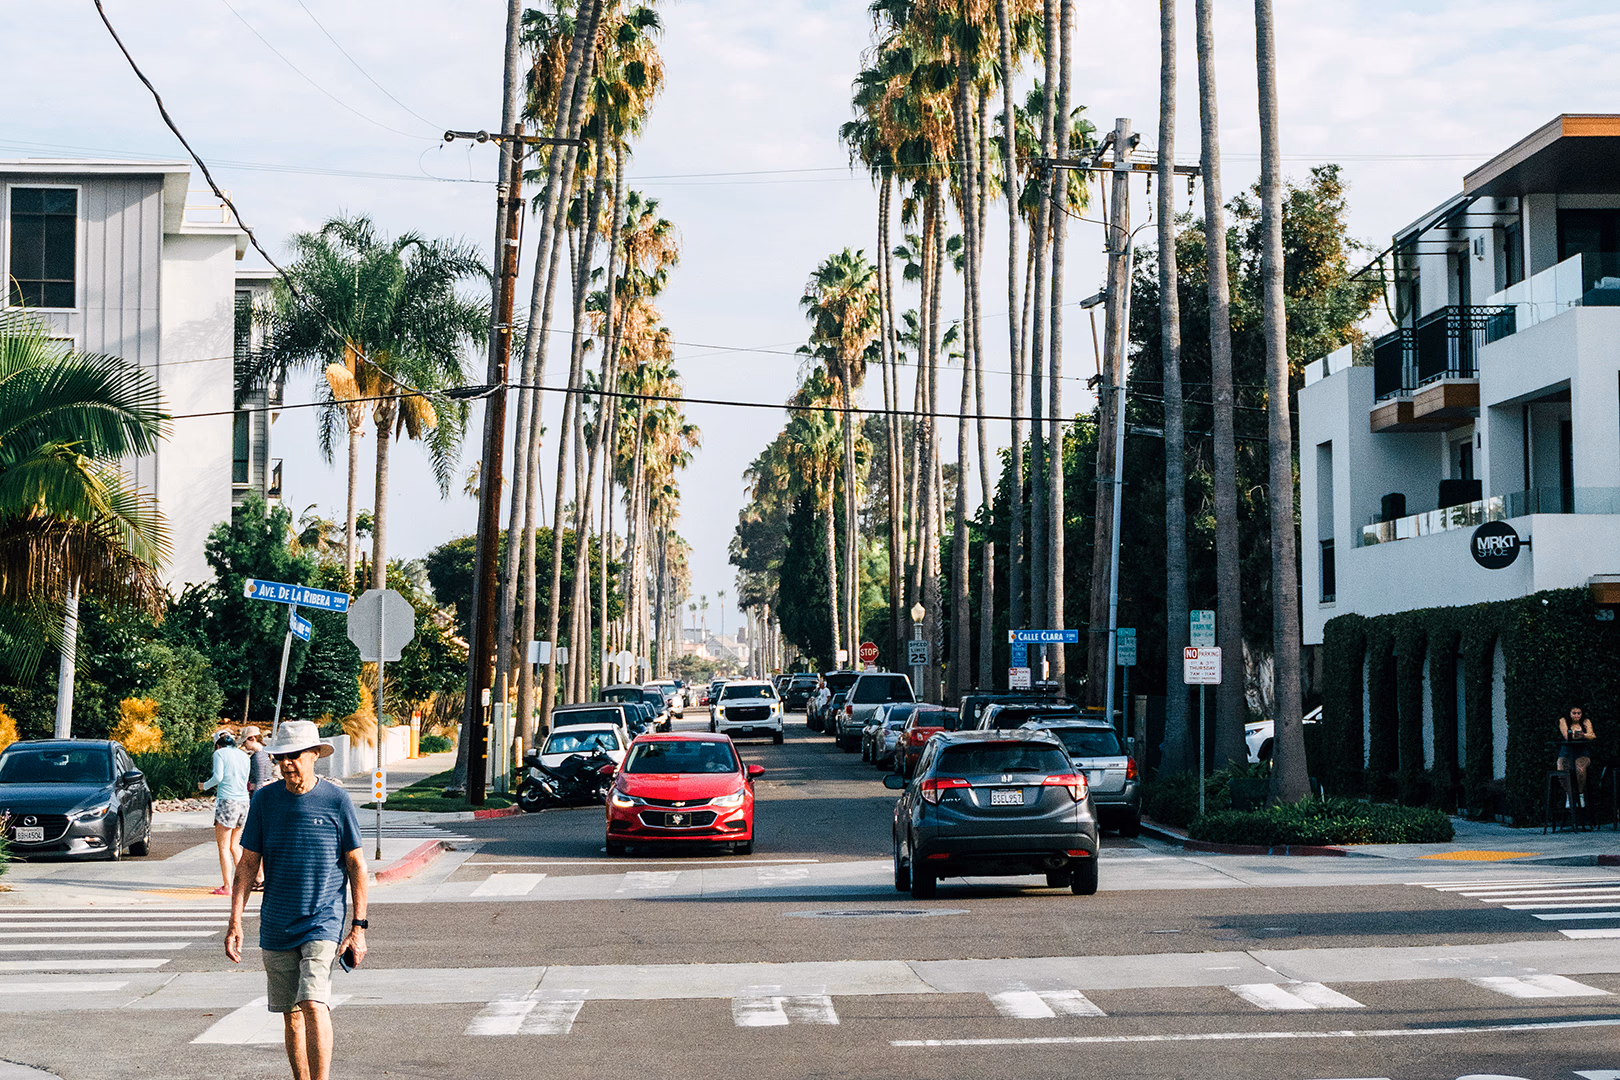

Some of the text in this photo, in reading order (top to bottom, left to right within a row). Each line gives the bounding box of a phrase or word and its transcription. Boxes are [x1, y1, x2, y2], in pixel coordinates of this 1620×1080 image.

[1477, 535, 1516, 550] MRKT
[1018, 632, 1038, 640] CALLE
[1041, 632, 1064, 640] CLARA
[860, 648, 878, 656] STOP
[1186, 650, 1198, 658] NO
[911, 653, 926, 663] 25
